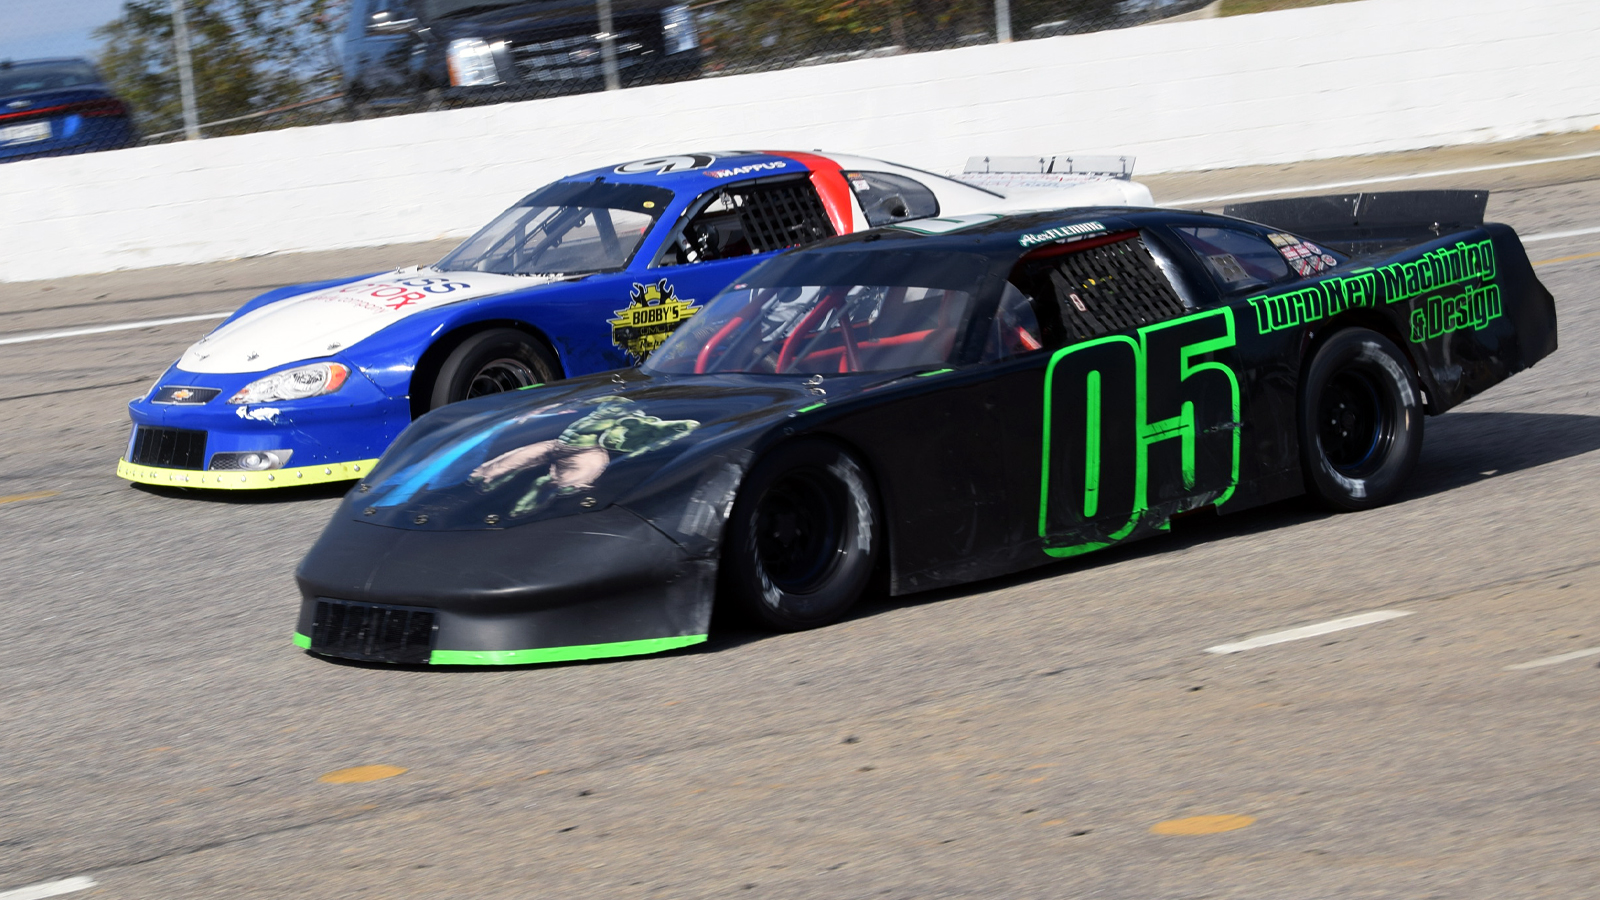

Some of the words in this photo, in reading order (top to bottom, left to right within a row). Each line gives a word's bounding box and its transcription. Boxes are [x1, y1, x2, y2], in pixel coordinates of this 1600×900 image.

[716, 161, 786, 178] MAPPUS
[632, 305, 679, 326] BOBBY'S
[1248, 288, 1323, 335] Turn
[1320, 269, 1376, 316] Key
[1376, 239, 1496, 304] Machining
[1410, 307, 1427, 343] &
[1427, 284, 1502, 339] Design
[1038, 305, 1241, 558] 05
